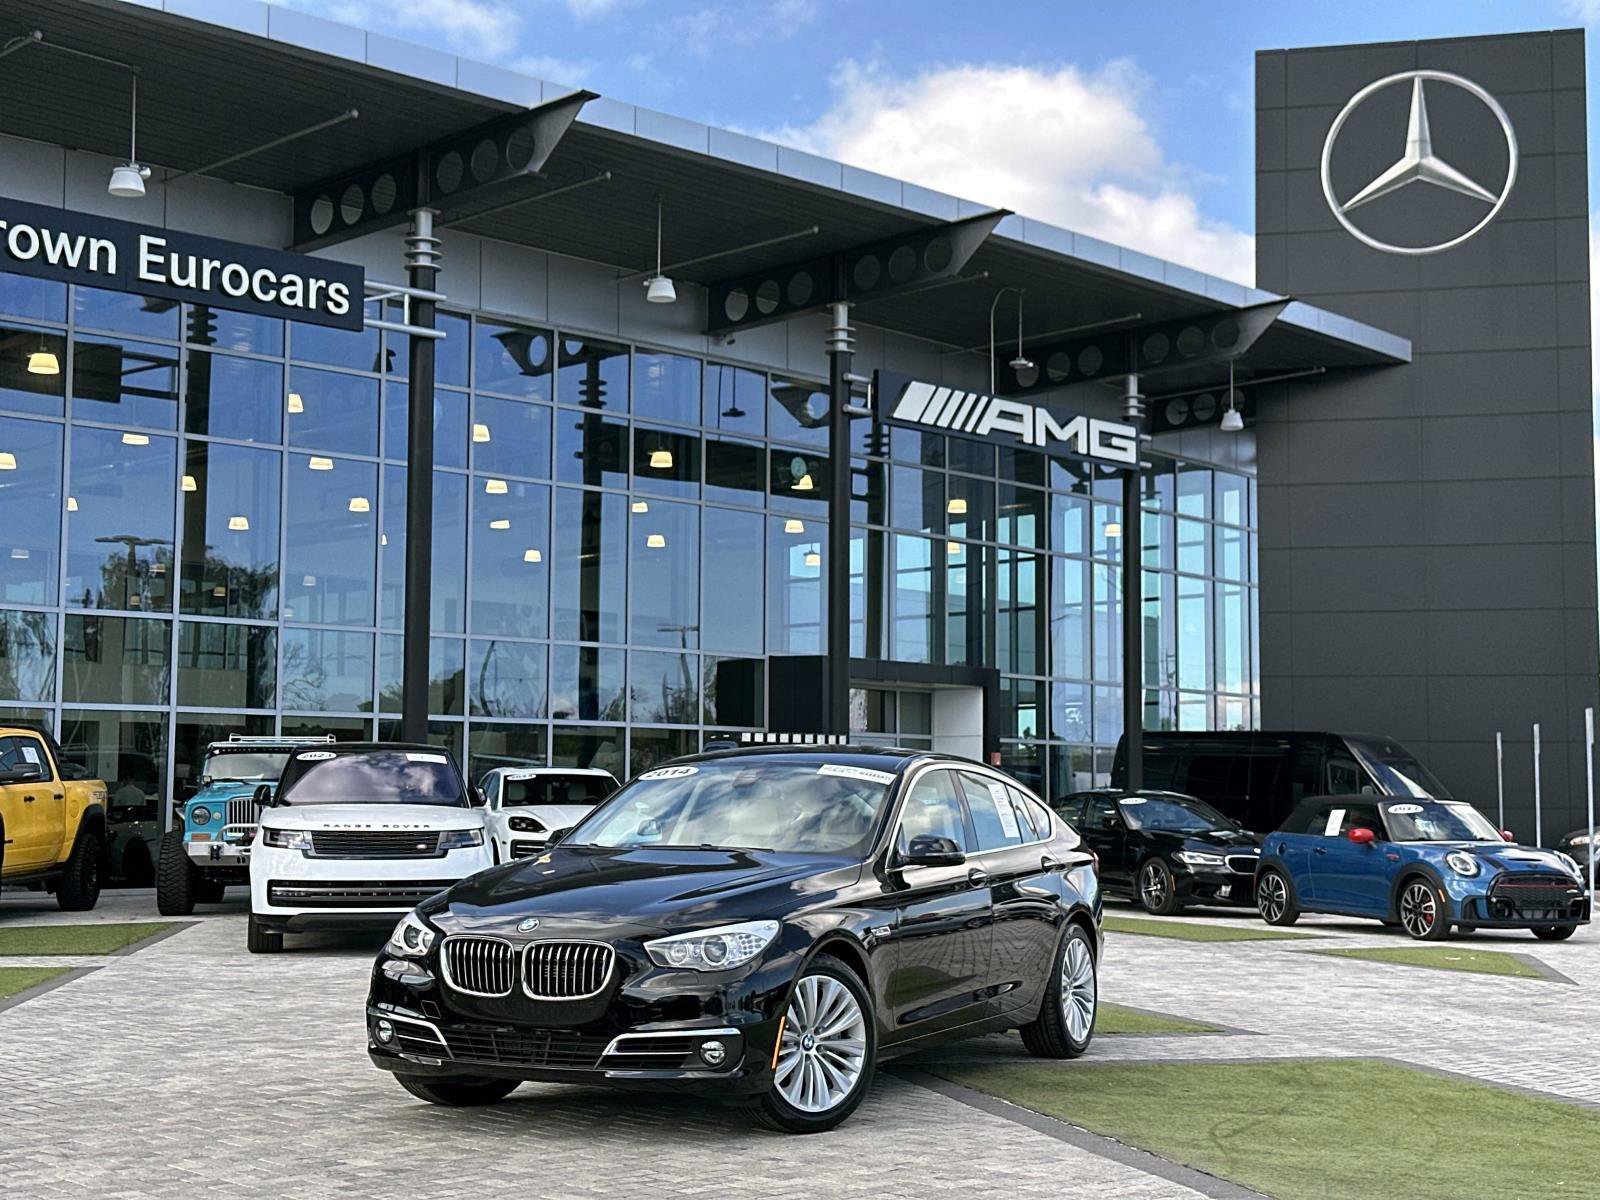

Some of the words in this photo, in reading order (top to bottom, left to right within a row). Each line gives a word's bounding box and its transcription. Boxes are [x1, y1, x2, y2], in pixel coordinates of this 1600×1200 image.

[138, 234, 350, 316] Eurocars
[976, 398, 1137, 464] AMG
[643, 768, 692, 779] 2014
